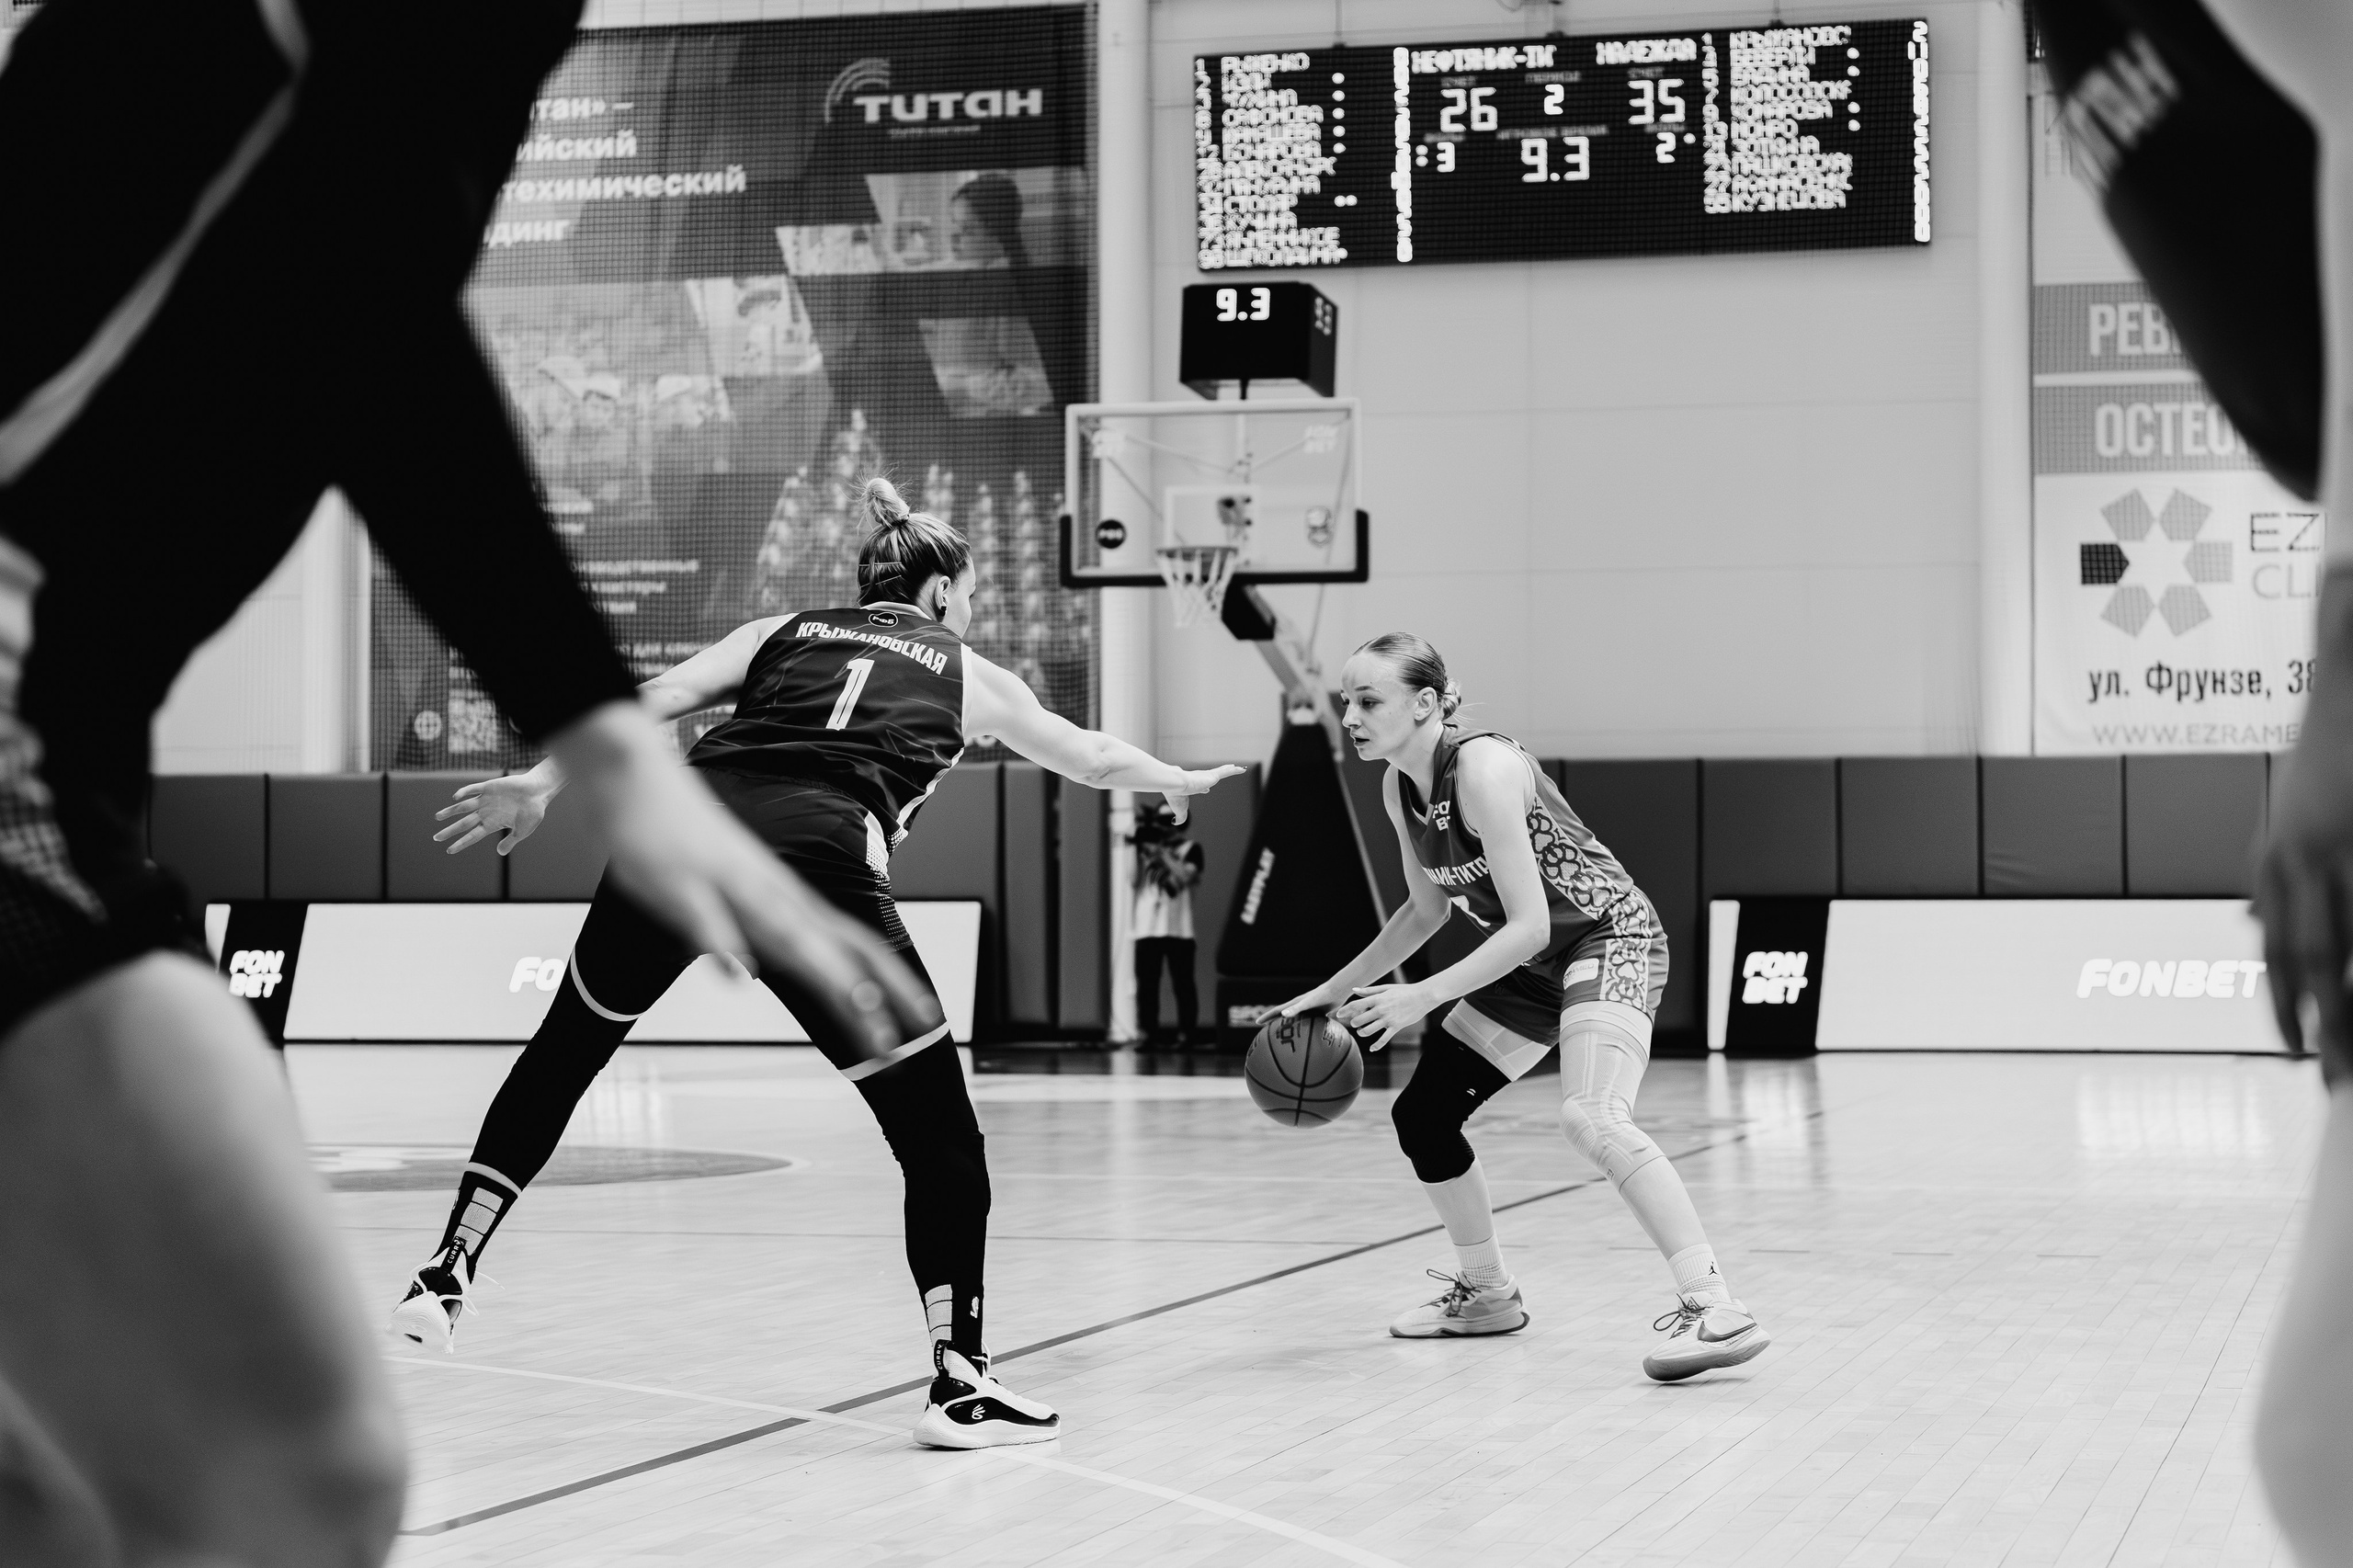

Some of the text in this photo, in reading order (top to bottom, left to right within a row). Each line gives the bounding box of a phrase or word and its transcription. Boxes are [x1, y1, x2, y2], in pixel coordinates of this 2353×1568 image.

[1440, 86, 1497, 132] 26
[1543, 84, 1564, 115] 2
[1628, 78, 1686, 125] 35
[1437, 142, 1455, 173] 3
[1521, 136, 1590, 182] 9.3
[1655, 131, 1676, 164] 2
[483, 220, 571, 248] динг
[1216, 287, 1271, 322] 9.3
[2089, 303, 2182, 357] РЕВ
[2095, 402, 2248, 458] ОСТЕО
[795, 621, 949, 676] КРЫЖАНОВСКАЯ
[825, 658, 875, 731] 1
[2087, 670, 2130, 705] ул.
[2144, 660, 2272, 705] Фрунзе,
[229, 949, 285, 974] FON
[1743, 950, 1808, 978] FON
[2075, 959, 2268, 999] FONBET
[228, 972, 283, 998] BET
[1742, 976, 1808, 1004] BET
